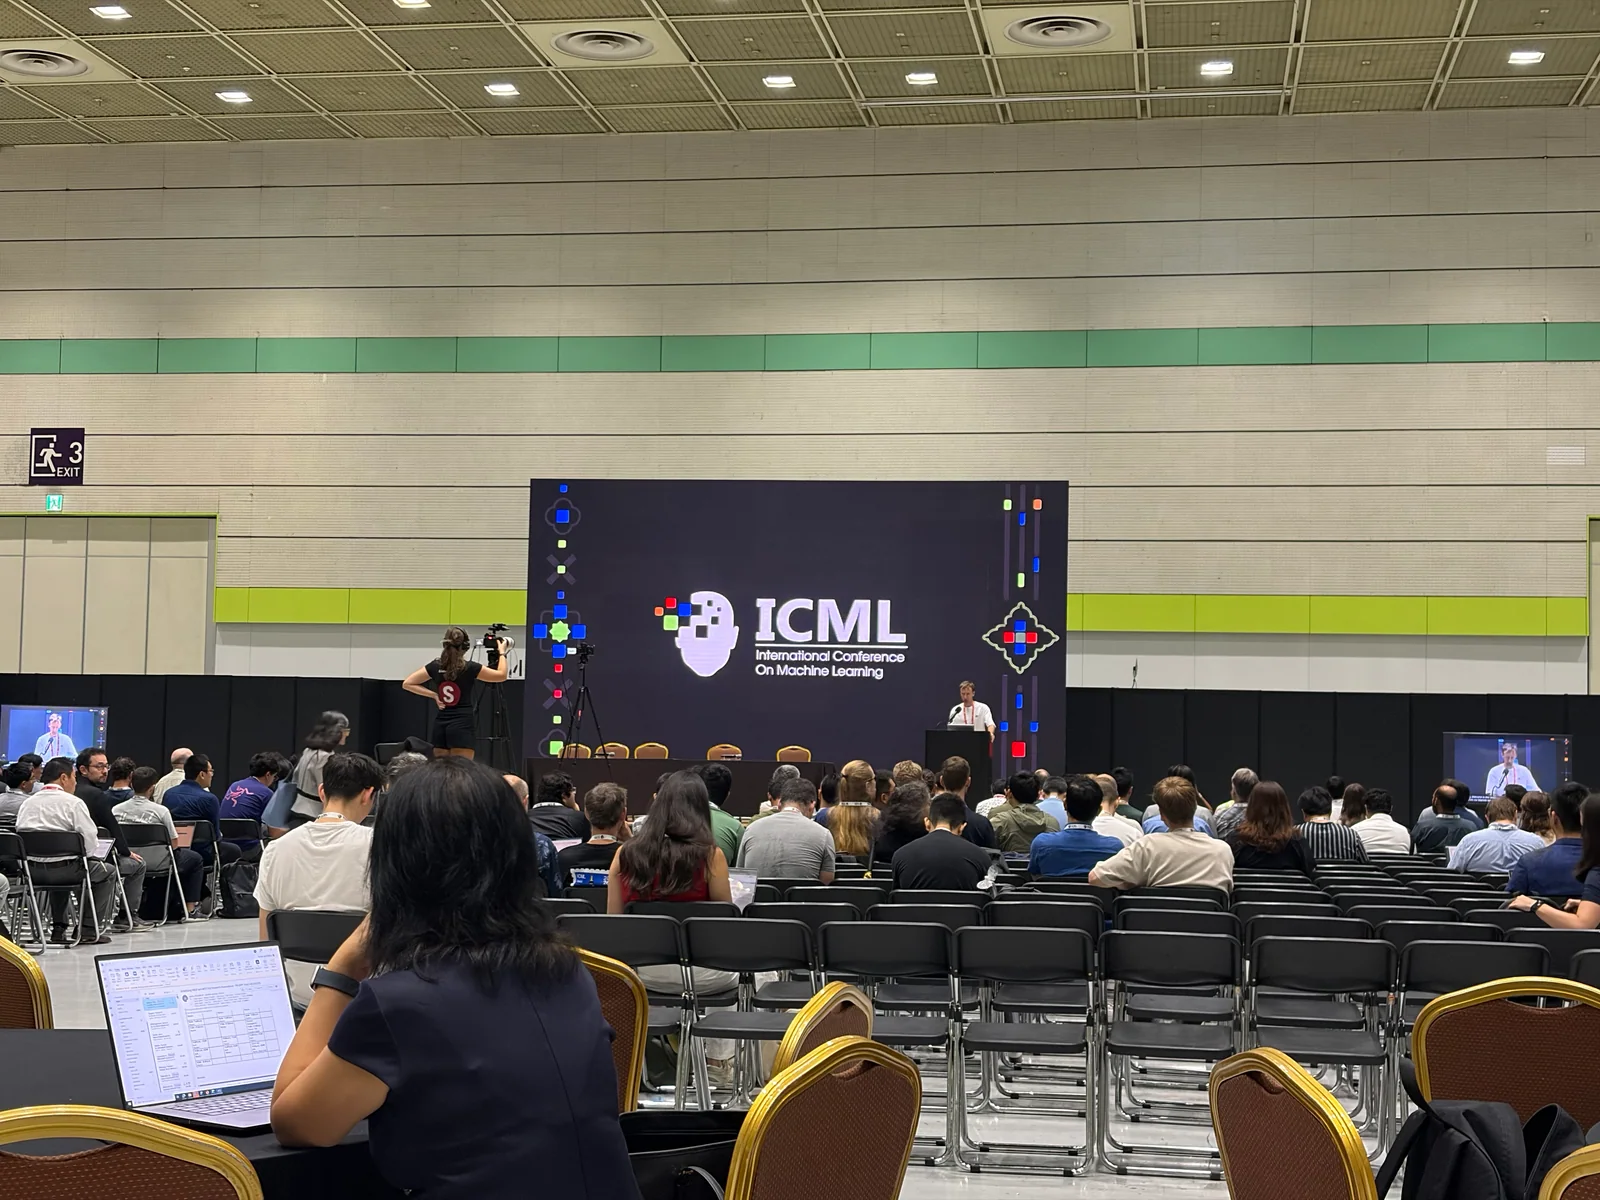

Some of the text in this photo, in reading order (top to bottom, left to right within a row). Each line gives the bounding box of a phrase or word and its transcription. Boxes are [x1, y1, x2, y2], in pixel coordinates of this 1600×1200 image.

[69, 441, 83, 464] 3
[57, 467, 80, 477] EXIT
[755, 598, 907, 643] ICML
[755, 650, 906, 663] International Conference
[755, 664, 884, 680] On Machine Learning
[442, 685, 455, 703] S
